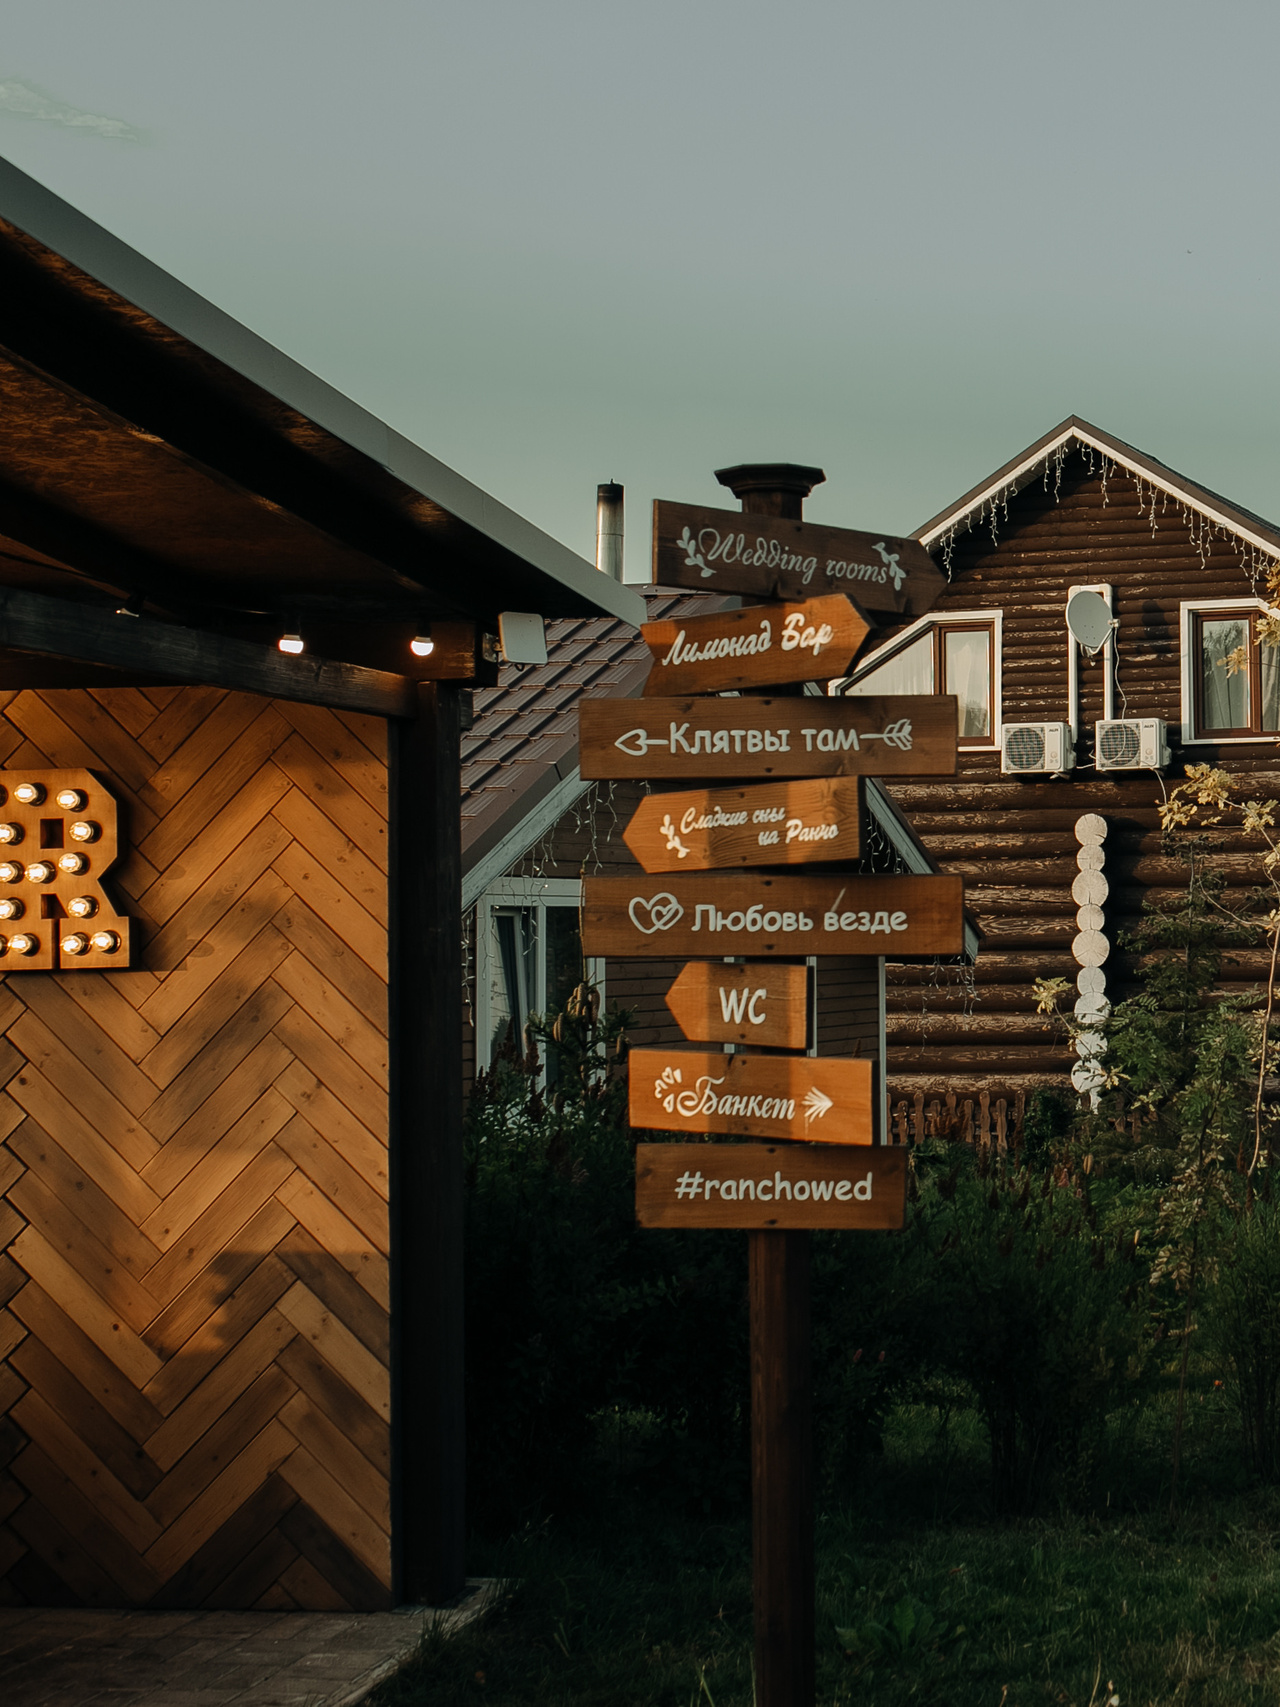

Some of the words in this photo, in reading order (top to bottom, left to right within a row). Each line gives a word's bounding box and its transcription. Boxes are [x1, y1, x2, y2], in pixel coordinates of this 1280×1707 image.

[697, 527, 818, 585] Wedding
[825, 558, 888, 584] rooms
[661, 619, 772, 666] Лимонад
[780, 612, 834, 656] Бар
[668, 721, 791, 755] Клятвы
[801, 727, 860, 752] там
[680, 806, 749, 834] Сладкие
[752, 807, 786, 824] сны
[758, 829, 781, 846] на
[785, 818, 839, 844] Ранчо
[691, 903, 814, 933] Любовь
[823, 910, 909, 935] везде
[718, 986, 767, 1026] WC
[676, 1075, 797, 1121] Банкет
[674, 1170, 874, 1202] #ranchowed
